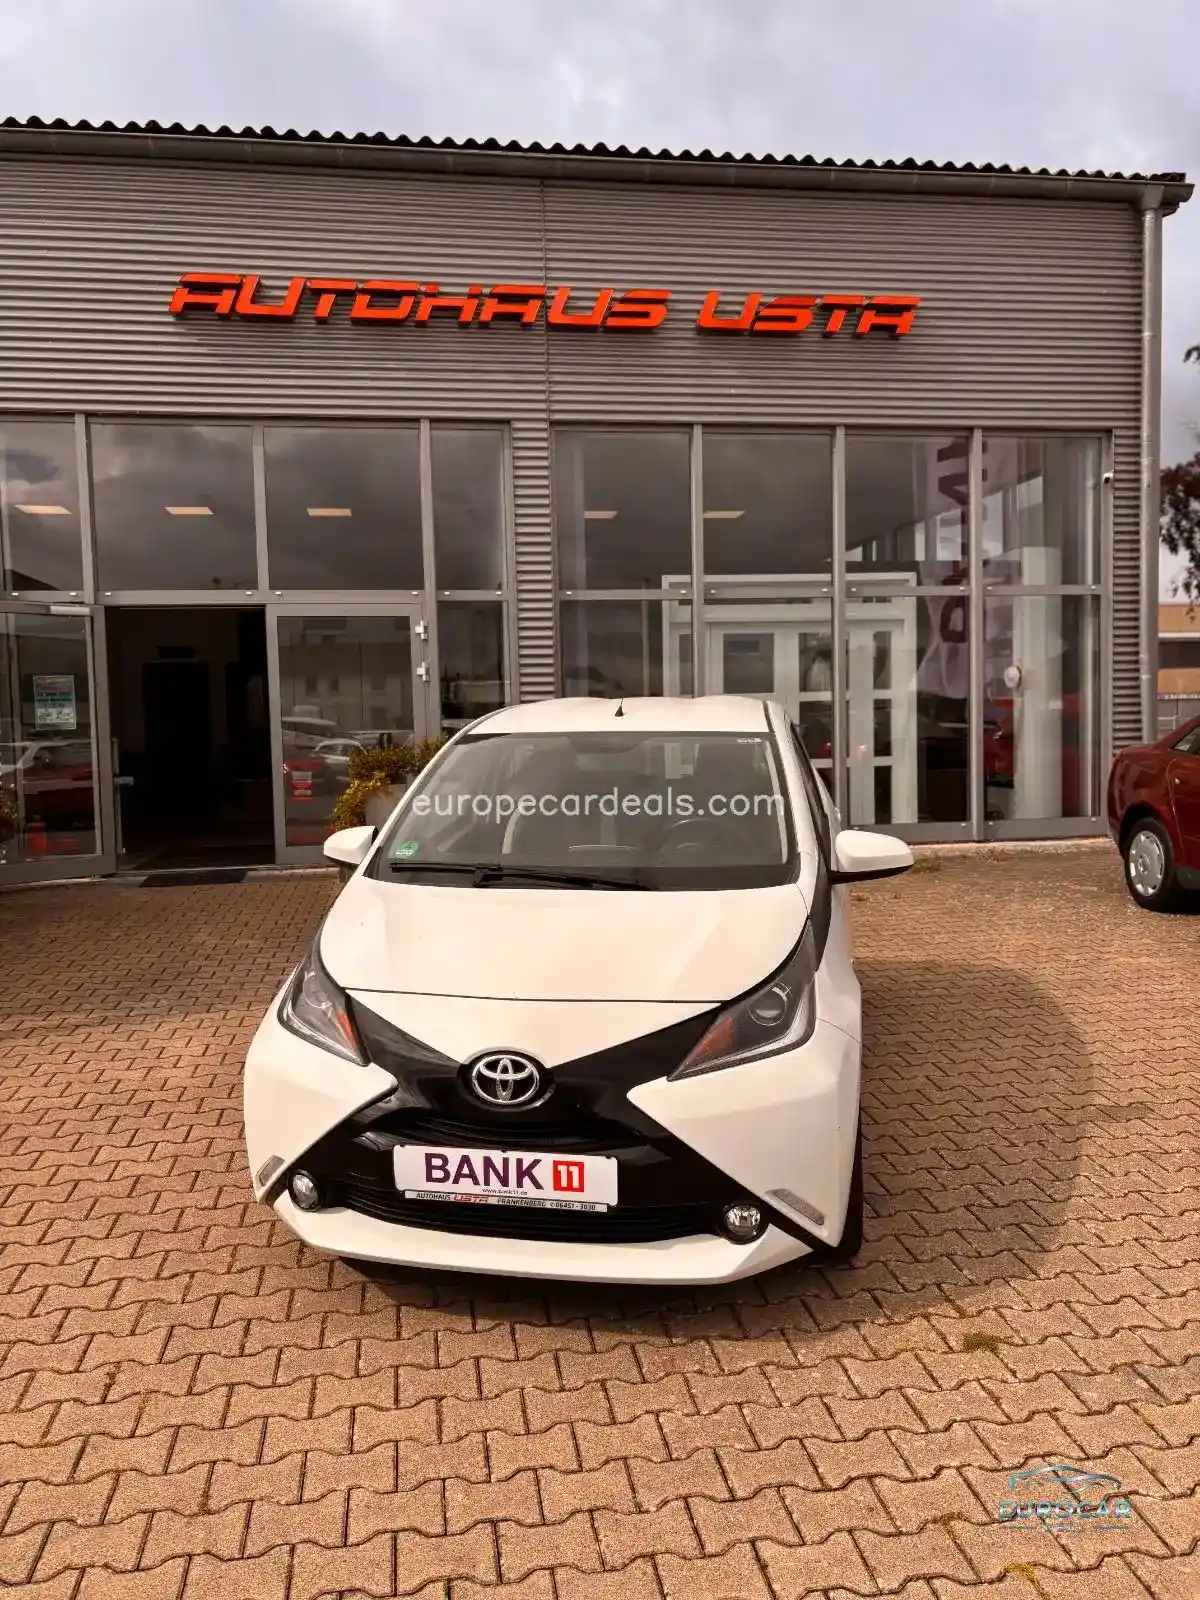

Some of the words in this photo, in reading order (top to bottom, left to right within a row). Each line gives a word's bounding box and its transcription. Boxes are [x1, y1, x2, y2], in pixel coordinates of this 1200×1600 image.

[169, 272, 671, 328] AUTOHAUS
[697, 290, 921, 337] USTA
[424, 1152, 545, 1191] BANK
[558, 1164, 580, 1189] 11
[416, 1192, 451, 1200] AUTOHAUS
[453, 1194, 489, 1203] USTA
[497, 1198, 546, 1207] FRANKENBERG
